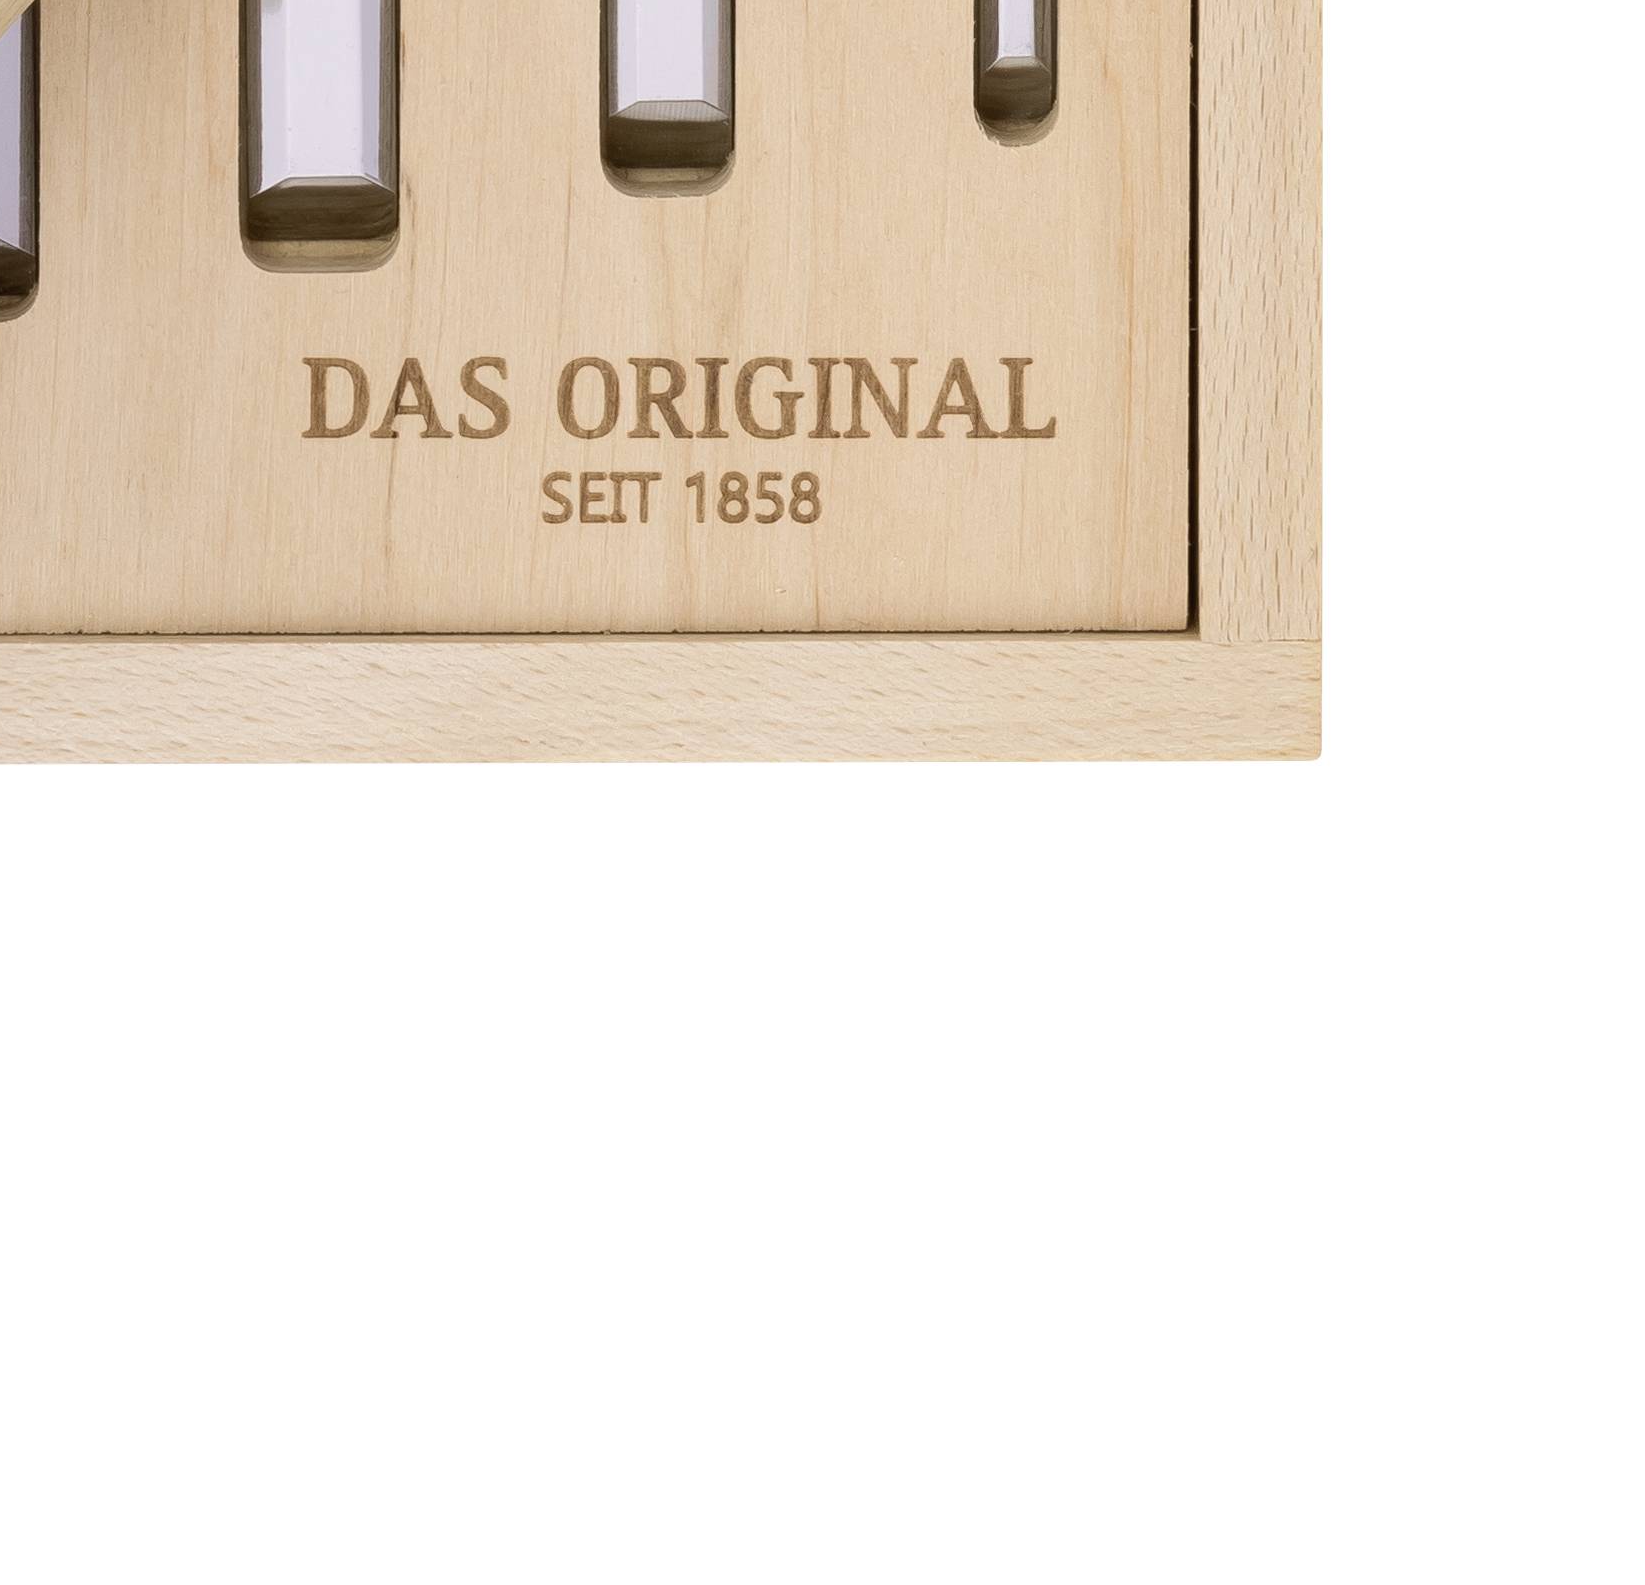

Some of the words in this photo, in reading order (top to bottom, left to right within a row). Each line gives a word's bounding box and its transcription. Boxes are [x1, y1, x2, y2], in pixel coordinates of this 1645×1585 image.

[300, 356, 511, 440] DAS
[556, 356, 1057, 440] ORIGINAL
[541, 471, 662, 525] SEIT
[684, 471, 823, 525] 1858
